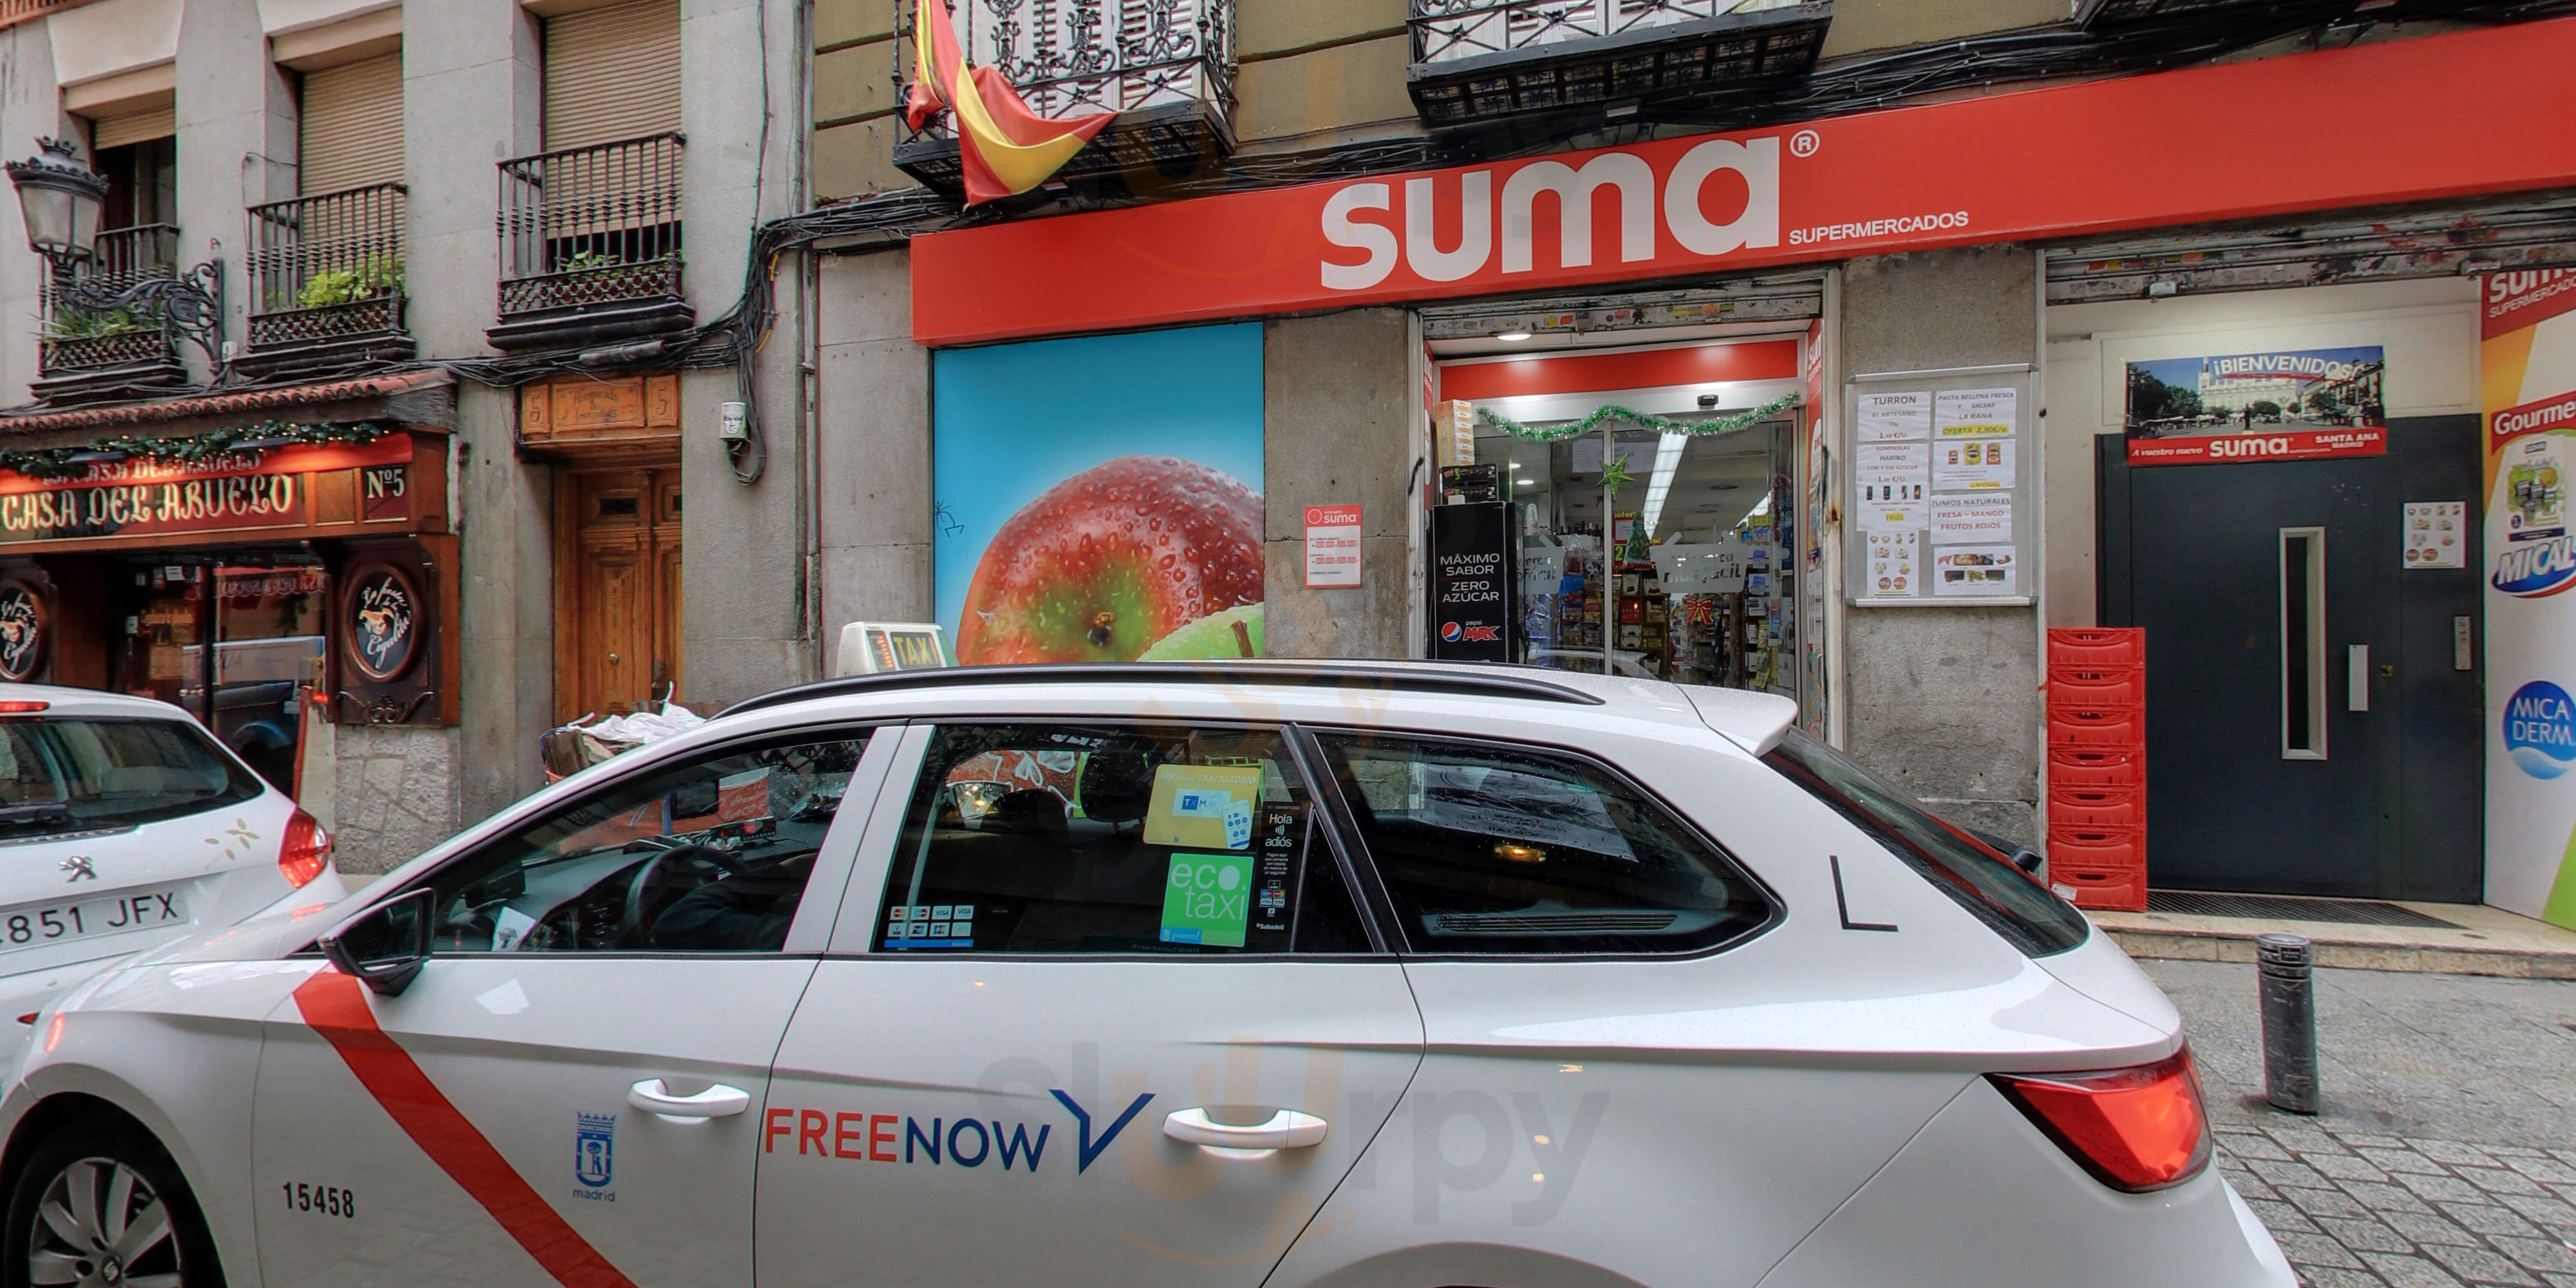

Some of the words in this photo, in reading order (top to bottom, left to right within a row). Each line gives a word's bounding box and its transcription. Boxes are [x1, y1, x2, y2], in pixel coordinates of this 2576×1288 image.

[1321, 136, 1779, 290] suma
[1790, 211, 1968, 245] SUPERMERCADOS
[529, 392, 540, 423] 5
[657, 389, 668, 415] 5
[2316, 434, 2354, 443] SANTA
[2356, 432, 2379, 441] ANA
[2210, 438, 2289, 457] suma
[2, 489, 78, 531] CASA
[86, 485, 151, 525] DEL
[157, 474, 295, 522] ABUELO
[1324, 514, 1357, 524] suma
[1440, 553, 1500, 565] MÁXIMO
[1446, 565, 1494, 576] SABOR
[1451, 581, 1490, 591] ZERO
[1442, 591, 1500, 602] AZÚCAR
[892, 637, 940, 665] TAXI
[2513, 697, 2570, 721] MICA
[1197, 774, 1217, 783] TAXI
[1219, 775, 1256, 784] MADRID
[1269, 813, 1292, 825] Hola
[1265, 836, 1292, 847] adiós
[1185, 886, 1246, 920] taxi
[0, 906, 83, 943] 851
[107, 892, 178, 927] JFX
[282, 1182, 355, 1218] 15458
[573, 1189, 615, 1202] madrid
